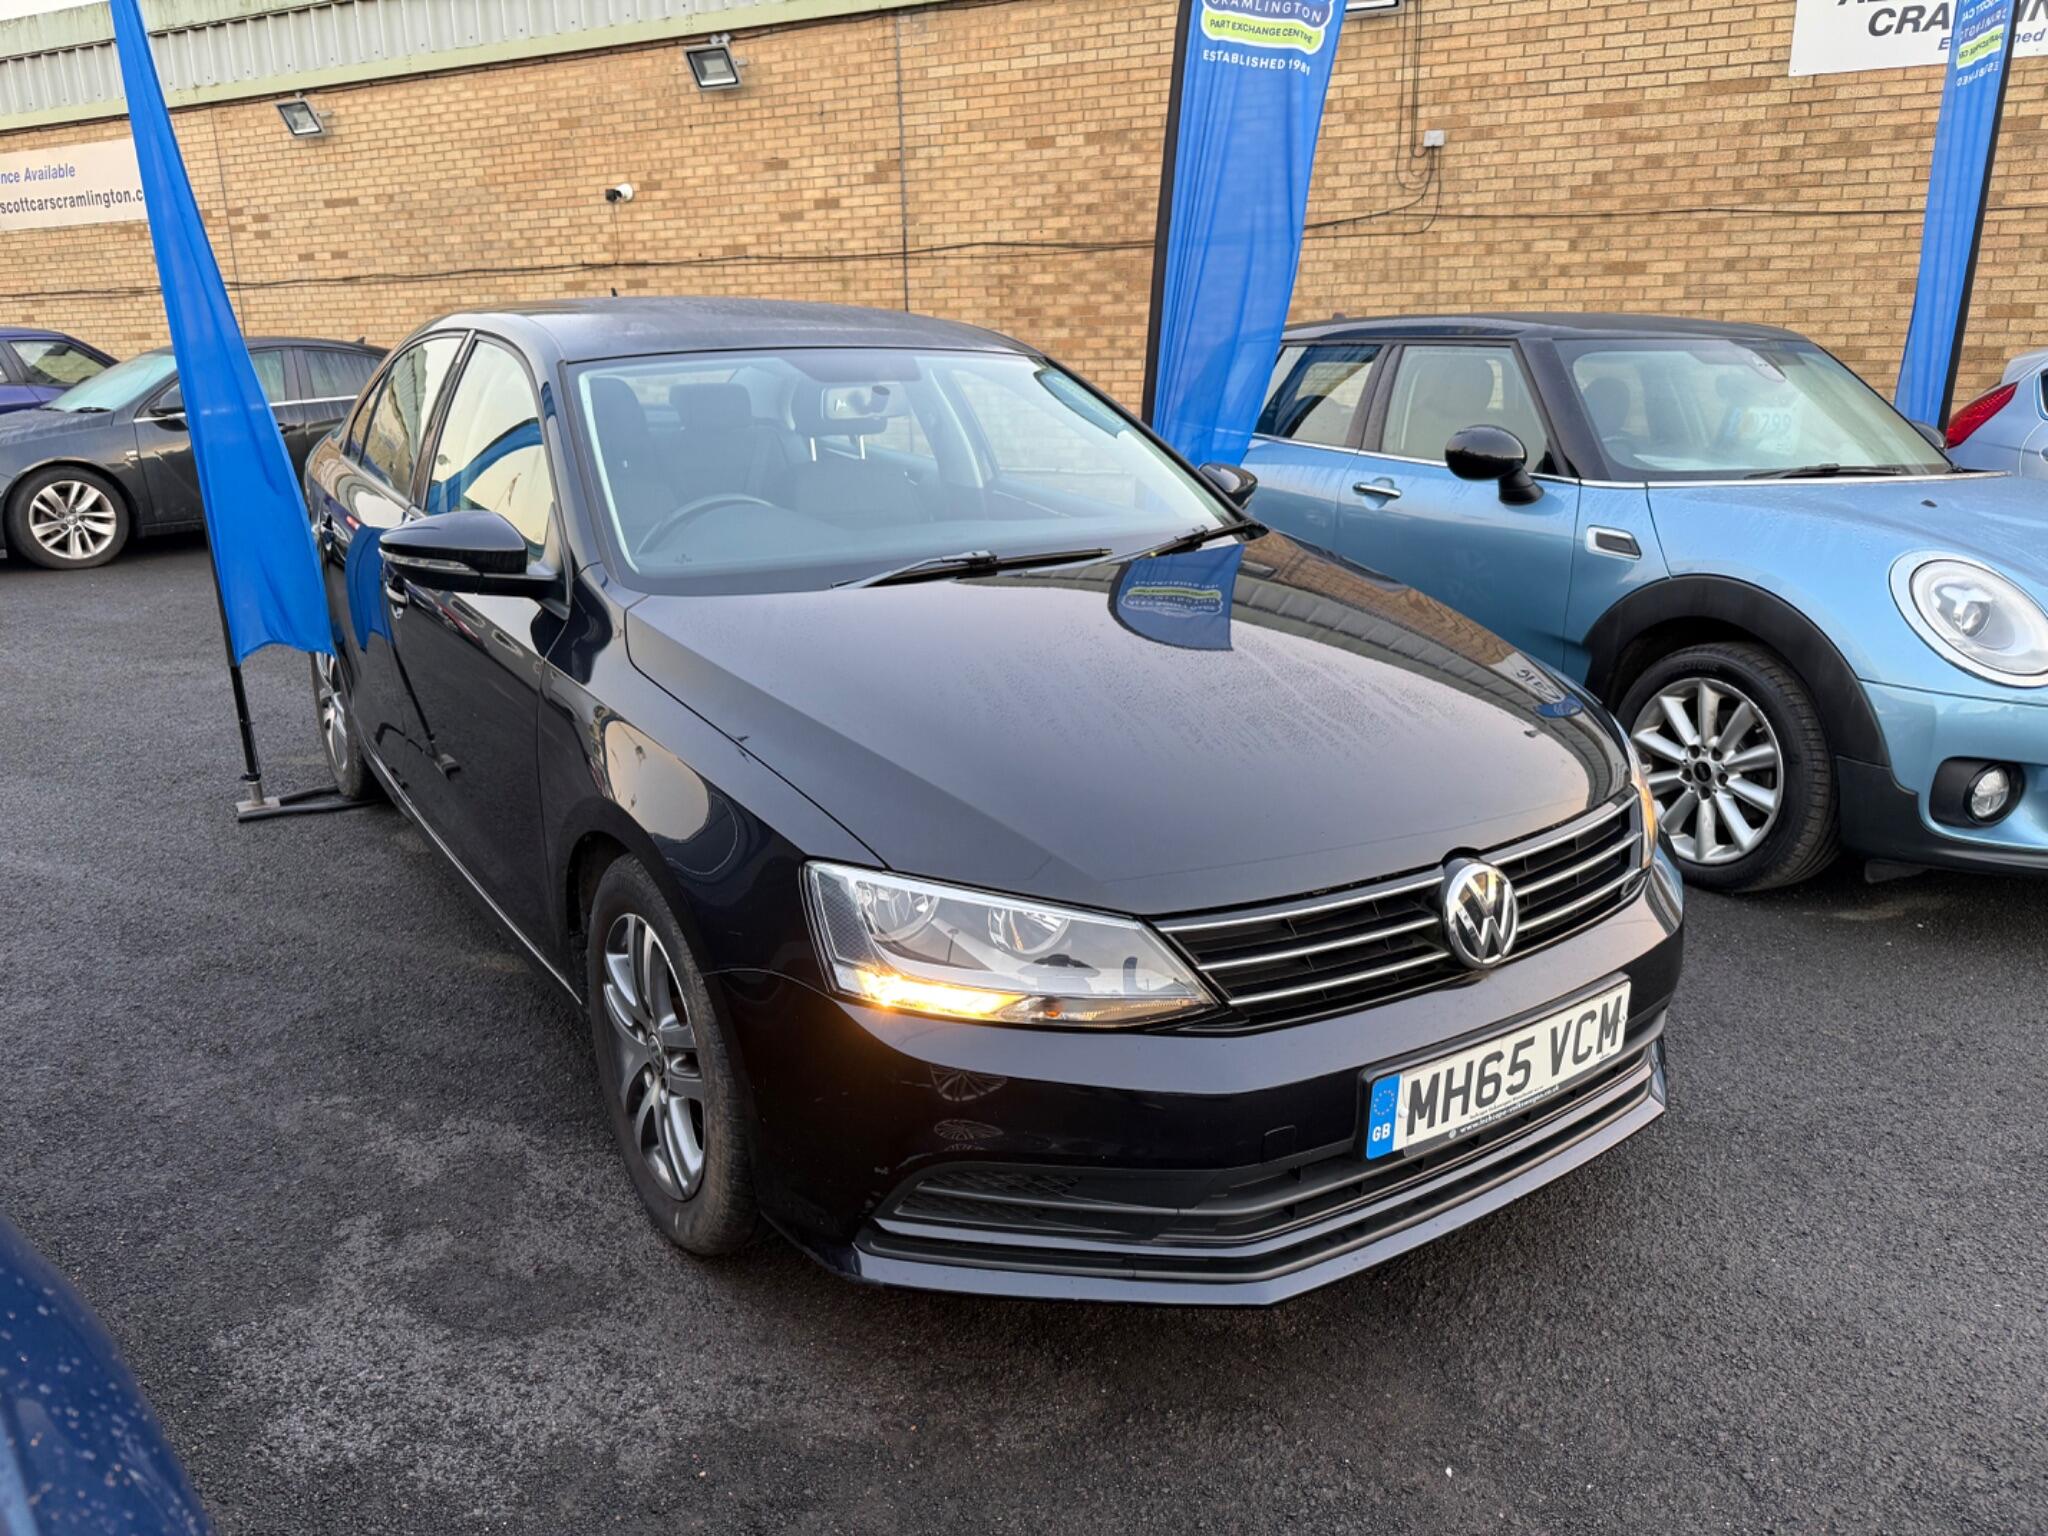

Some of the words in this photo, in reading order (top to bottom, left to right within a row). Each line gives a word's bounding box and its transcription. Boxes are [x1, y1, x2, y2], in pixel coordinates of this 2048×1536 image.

[1210, 19, 1230, 29] PART
[1232, 22, 1281, 37] EXCHANGE
[1203, 49, 1286, 70] ESTABLISHED
[24, 163, 75, 182] Available
[1406, 1035, 1536, 1137] MH65
[1550, 995, 1623, 1078] VCM
[1372, 1122, 1391, 1142] GB
